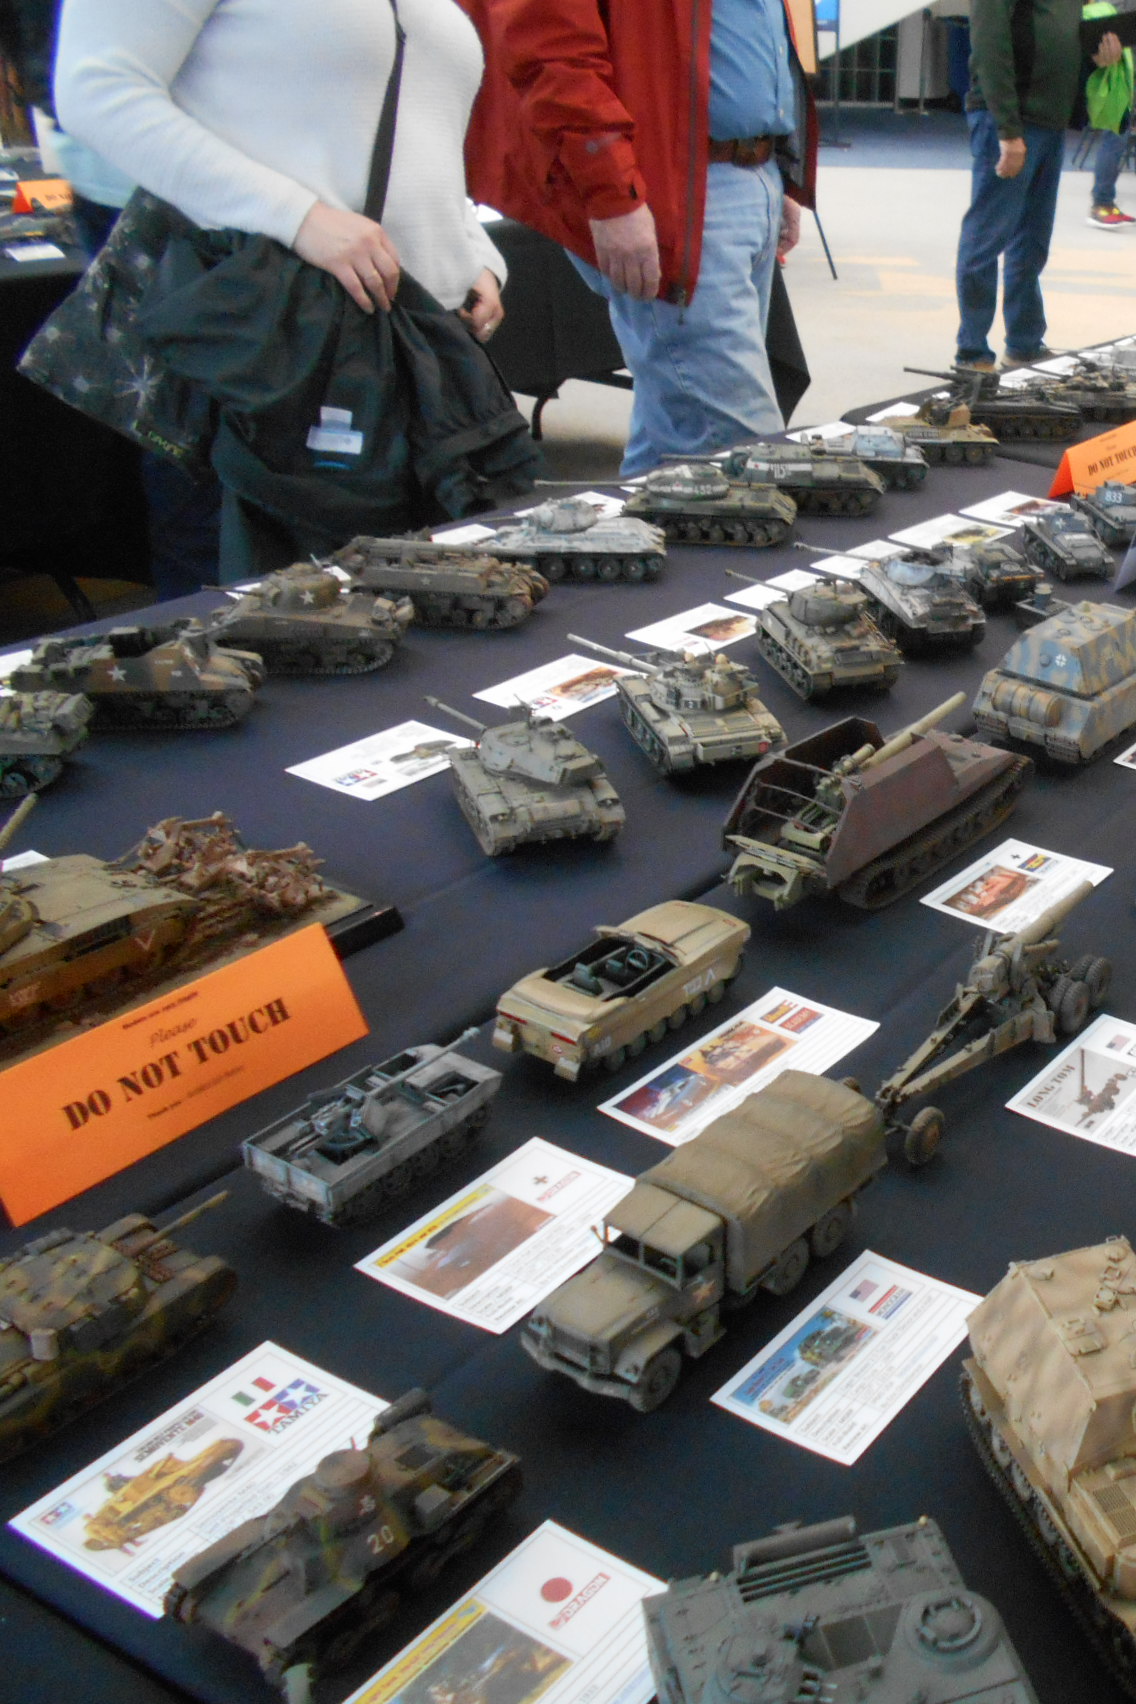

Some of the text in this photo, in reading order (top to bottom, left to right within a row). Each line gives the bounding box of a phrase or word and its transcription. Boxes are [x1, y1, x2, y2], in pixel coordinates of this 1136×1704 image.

[1088, 464, 1098, 476] DO
[1099, 456, 1114, 470] NOT
[62, 1087, 112, 1132] DO
[117, 1051, 182, 1103] NOT
[187, 997, 292, 1065] TOUCH
[1027, 1064, 1076, 1108] LONG TOM
[269, 1391, 329, 1436] TAMIYA
[366, 1525, 394, 1555] 20
[565, 1572, 609, 1617] DRAGON
